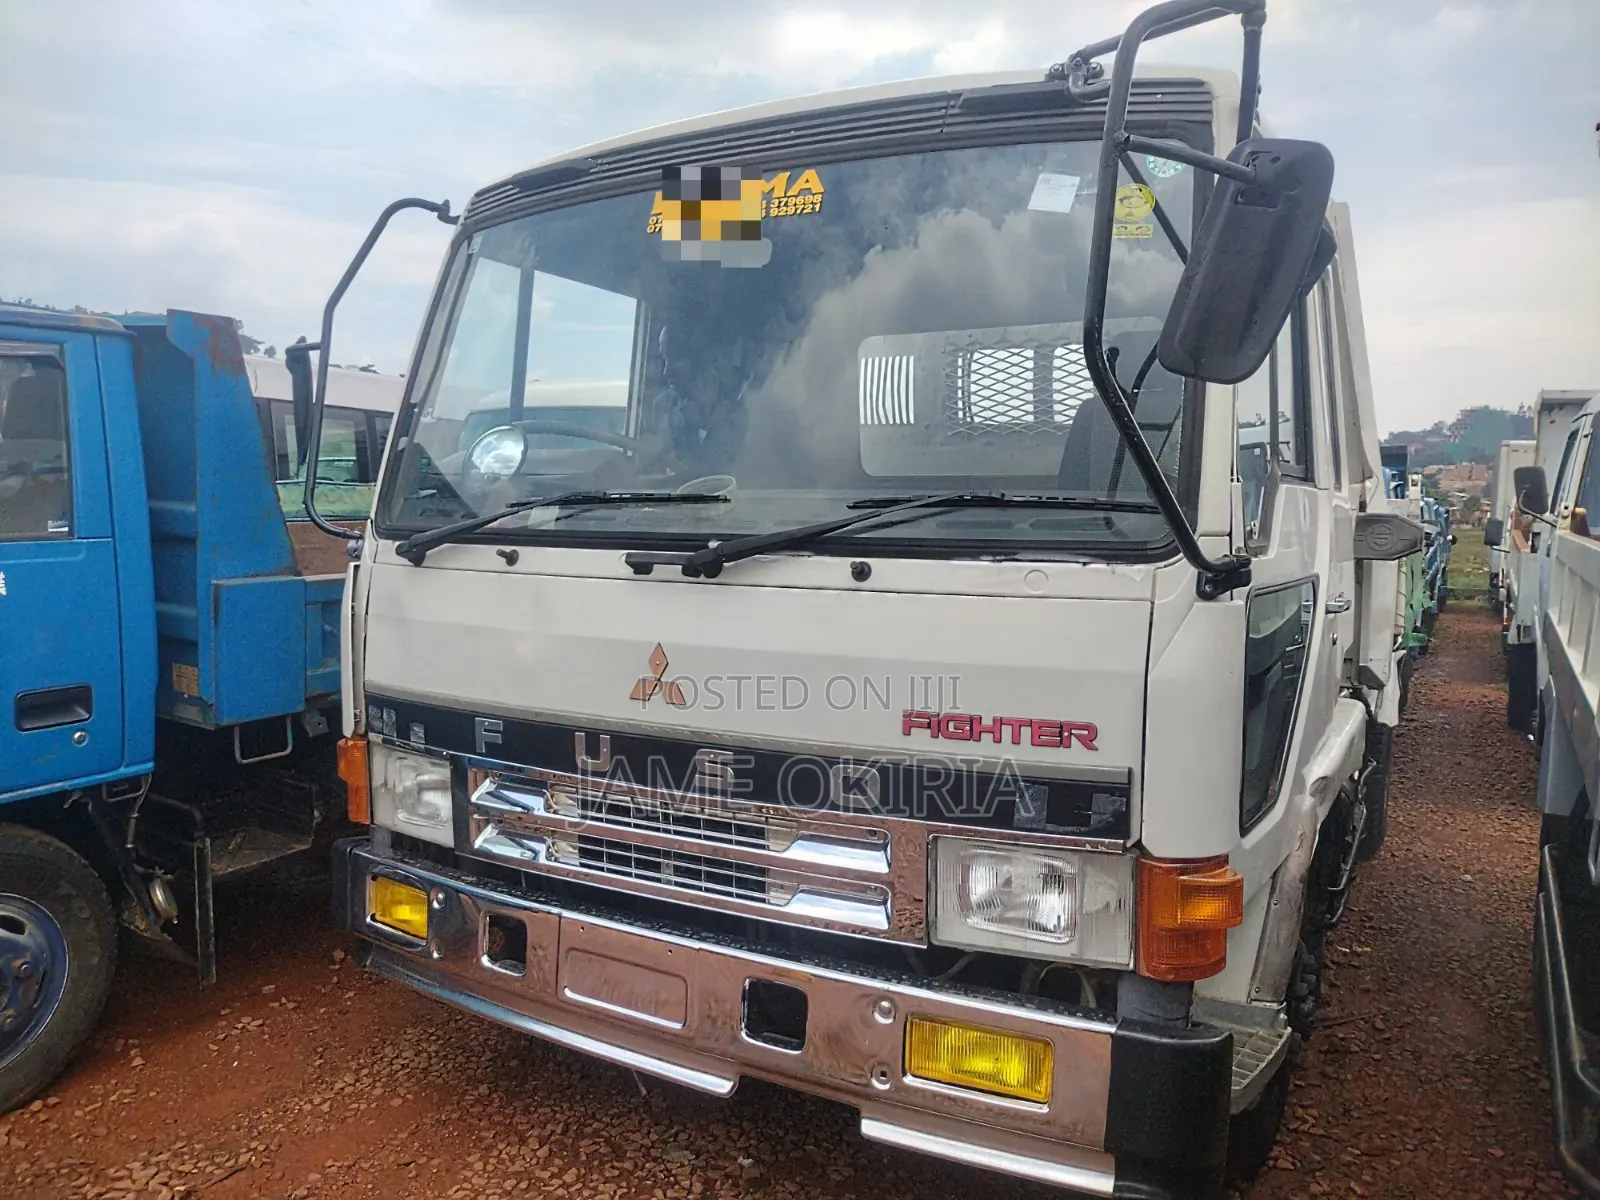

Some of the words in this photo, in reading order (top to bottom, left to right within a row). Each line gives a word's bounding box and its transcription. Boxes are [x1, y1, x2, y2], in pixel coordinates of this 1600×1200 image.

[770, 194, 823, 208] 379698
[769, 202, 821, 217] 929721
[902, 709, 1099, 751] FIGHTER
